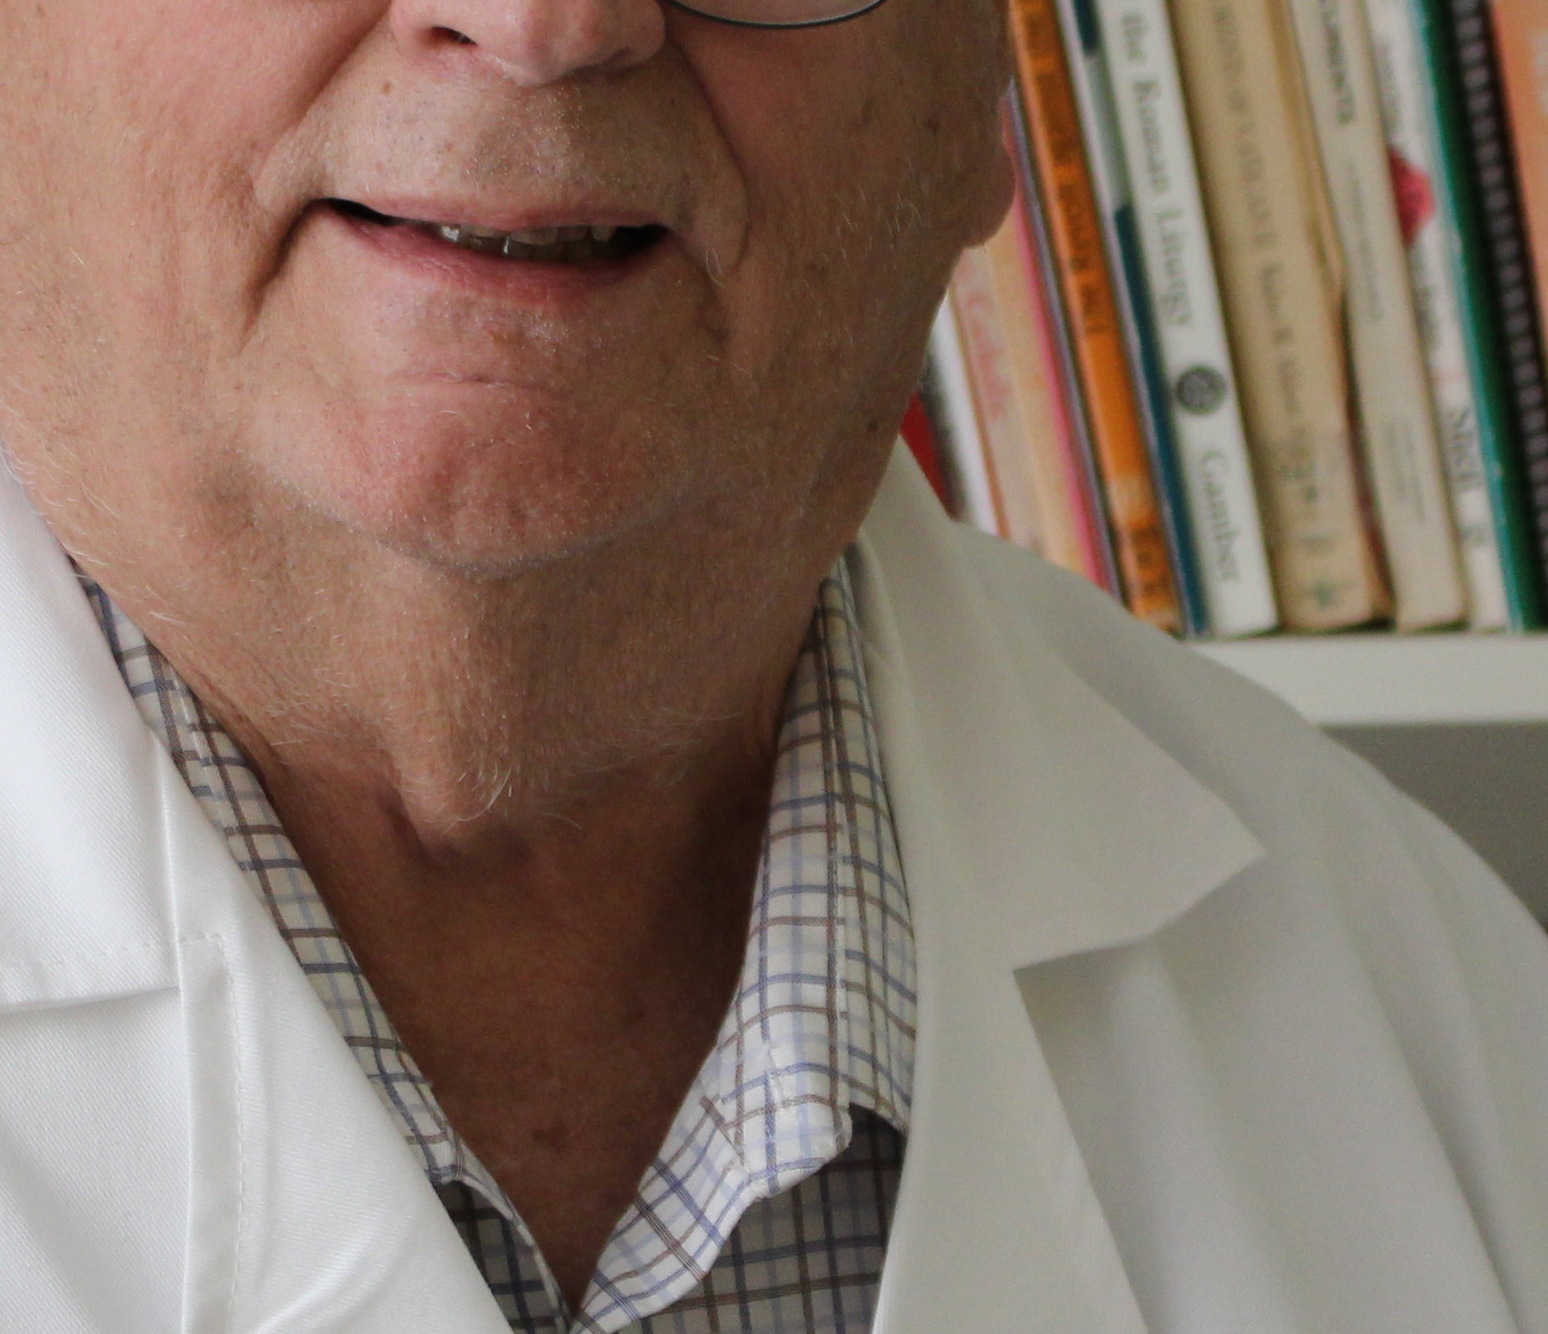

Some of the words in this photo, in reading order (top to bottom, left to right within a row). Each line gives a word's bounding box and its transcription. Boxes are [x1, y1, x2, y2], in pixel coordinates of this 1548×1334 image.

[1118, 11, 1158, 66] the
[1128, 75, 1181, 199] Roman
[1145, 205, 1205, 336] Liturgy
[1192, 447, 1250, 589] Gamber
